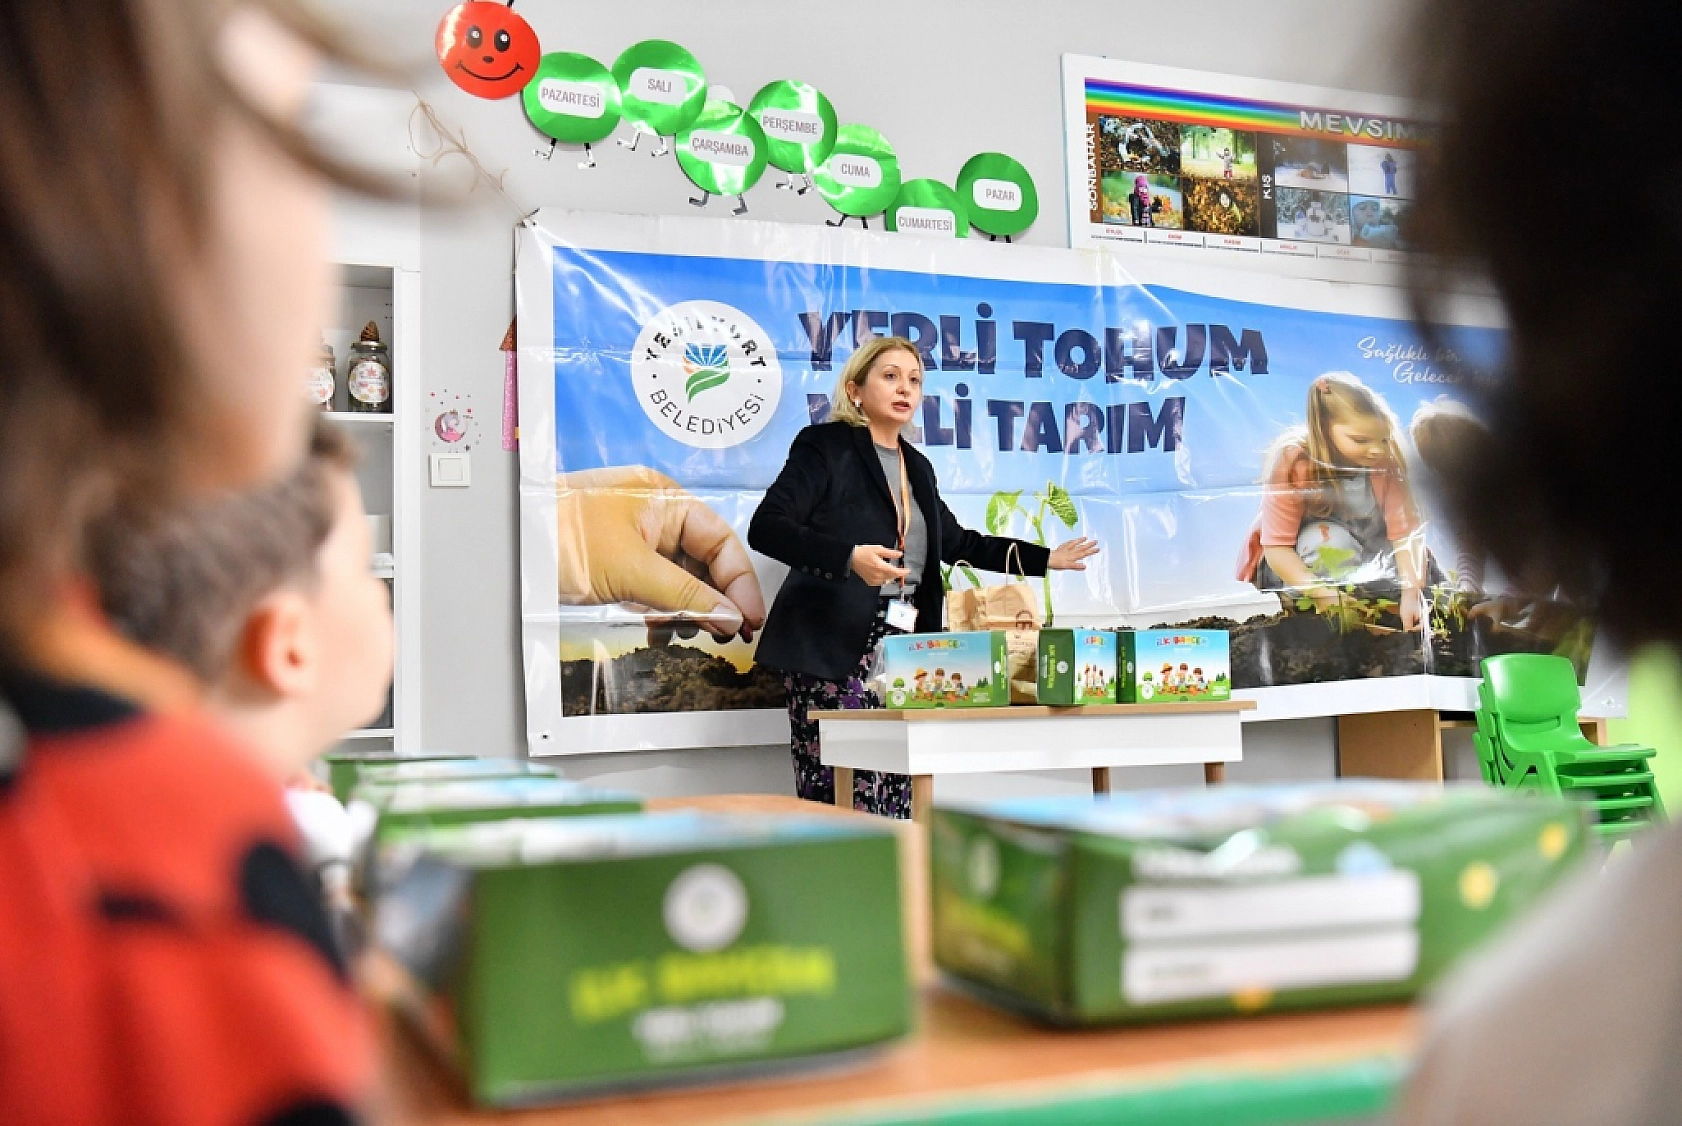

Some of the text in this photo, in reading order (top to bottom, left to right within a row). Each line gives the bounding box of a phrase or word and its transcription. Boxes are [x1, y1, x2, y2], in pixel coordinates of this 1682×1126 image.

[647, 78, 672, 93] SALI
[541, 86, 600, 108] PAZARTESİ
[762, 116, 818, 135] PERŞEMBE
[691, 137, 749, 156] ÇARŞAMBA
[841, 163, 871, 178] CUMA
[985, 188, 1015, 201] PAZAR
[898, 216, 953, 232] CUMARTESİ
[1012, 321, 1269, 383] TOHUM
[650, 389, 766, 435] BELEDİYESİ
[988, 396, 1186, 454] TARIM
